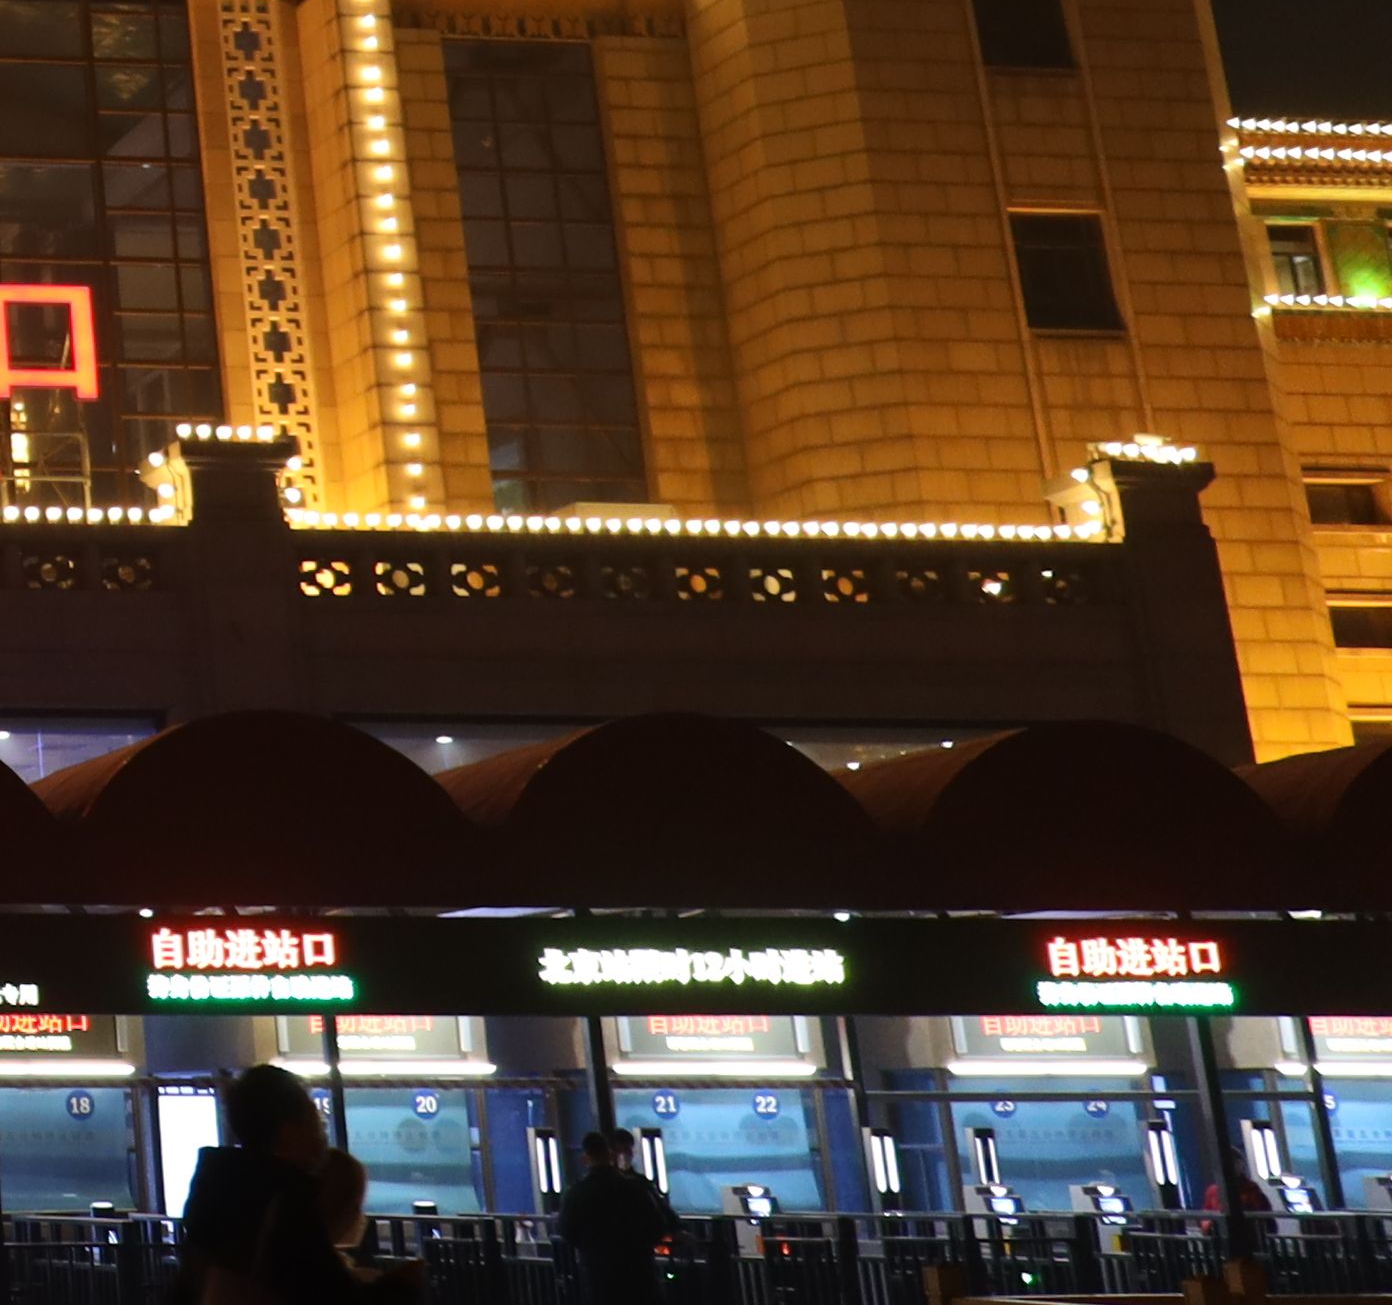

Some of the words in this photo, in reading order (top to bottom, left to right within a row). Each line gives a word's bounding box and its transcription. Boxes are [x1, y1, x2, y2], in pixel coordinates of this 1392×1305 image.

[152, 928, 335, 969] 自助进站口
[1047, 937, 1221, 976] 自助进站口
[70, 1097, 91, 1114] 18
[416, 1096, 437, 1113] 20
[655, 1096, 677, 1113] 21
[755, 1096, 777, 1113] 22
[1324, 1094, 1336, 1110] 5
